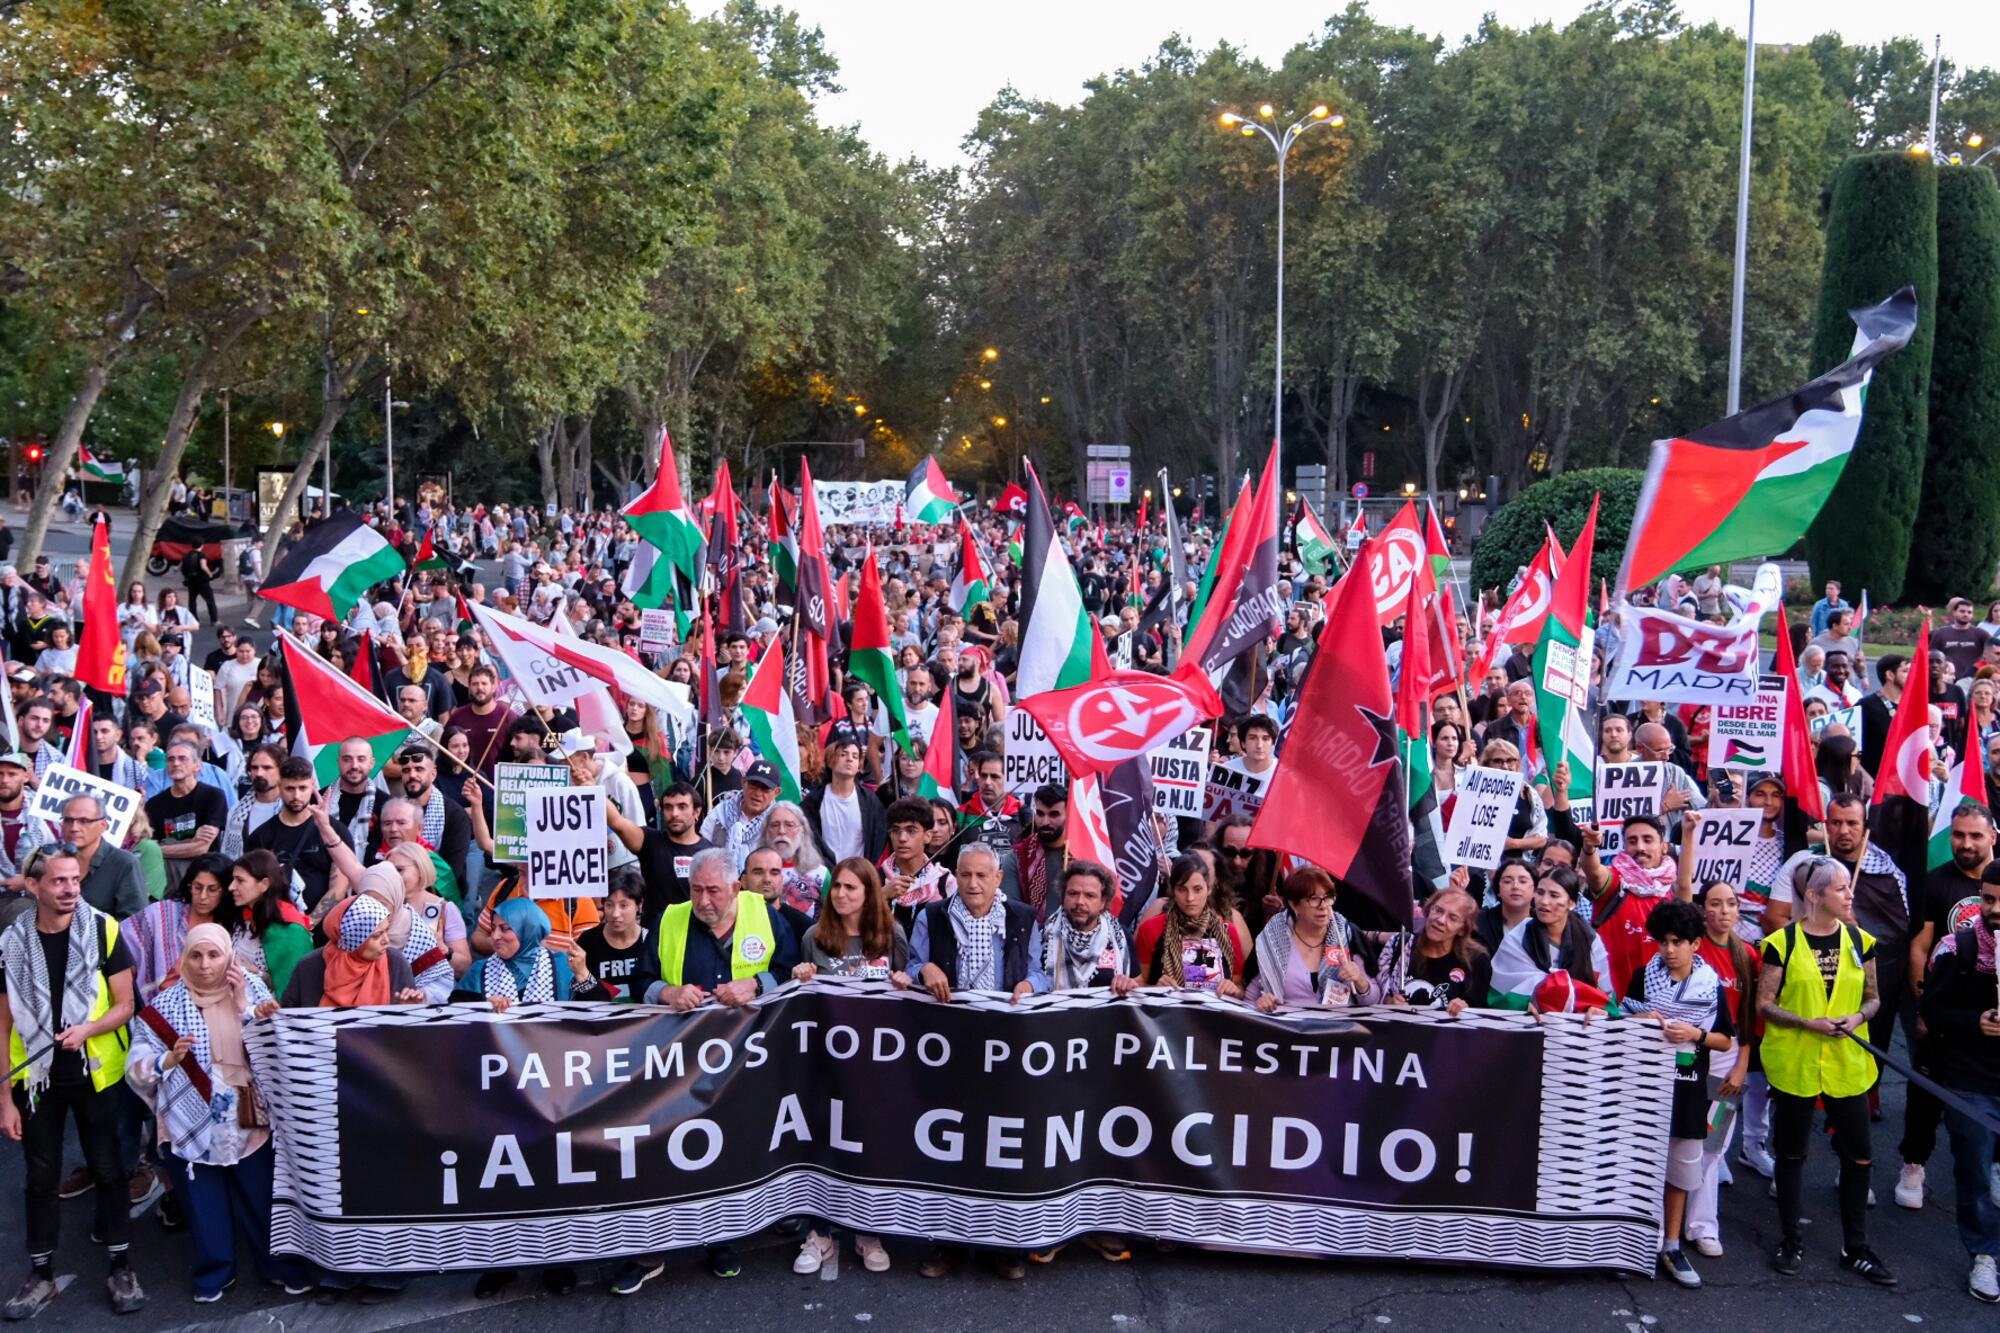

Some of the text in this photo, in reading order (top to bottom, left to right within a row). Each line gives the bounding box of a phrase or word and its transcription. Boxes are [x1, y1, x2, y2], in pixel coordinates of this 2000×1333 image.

[1717, 705, 1777, 721] LIBRE
[1717, 720, 1746, 728] DESDE
[1012, 713, 1046, 741] JUS
[1717, 728, 1743, 736] HASTA
[1168, 731, 1205, 752] AZ
[500, 765, 567, 780] RUPTURA DE
[1006, 755, 1062, 783] PEACE!
[1604, 765, 1657, 789] PAZ
[45, 771, 129, 812] NOT TO
[1465, 770, 1515, 799] All peoples
[501, 792, 524, 805] CON
[1169, 788, 1197, 811] N.U.
[1601, 796, 1653, 820] JUSTA
[537, 794, 595, 832] JUST
[1470, 804, 1499, 827] LOSE
[497, 835, 517, 845] STOP
[1699, 820, 1755, 846] PAZ
[1457, 836, 1492, 861] all wars.
[531, 848, 606, 886] PEACE!
[1691, 859, 1742, 884] JUSTA
[481, 1021, 1428, 1090] PAREMOS TODO POR PALESTINA
[440, 1093, 1473, 1204] ¡ALTO AL GENOCIDIO!
